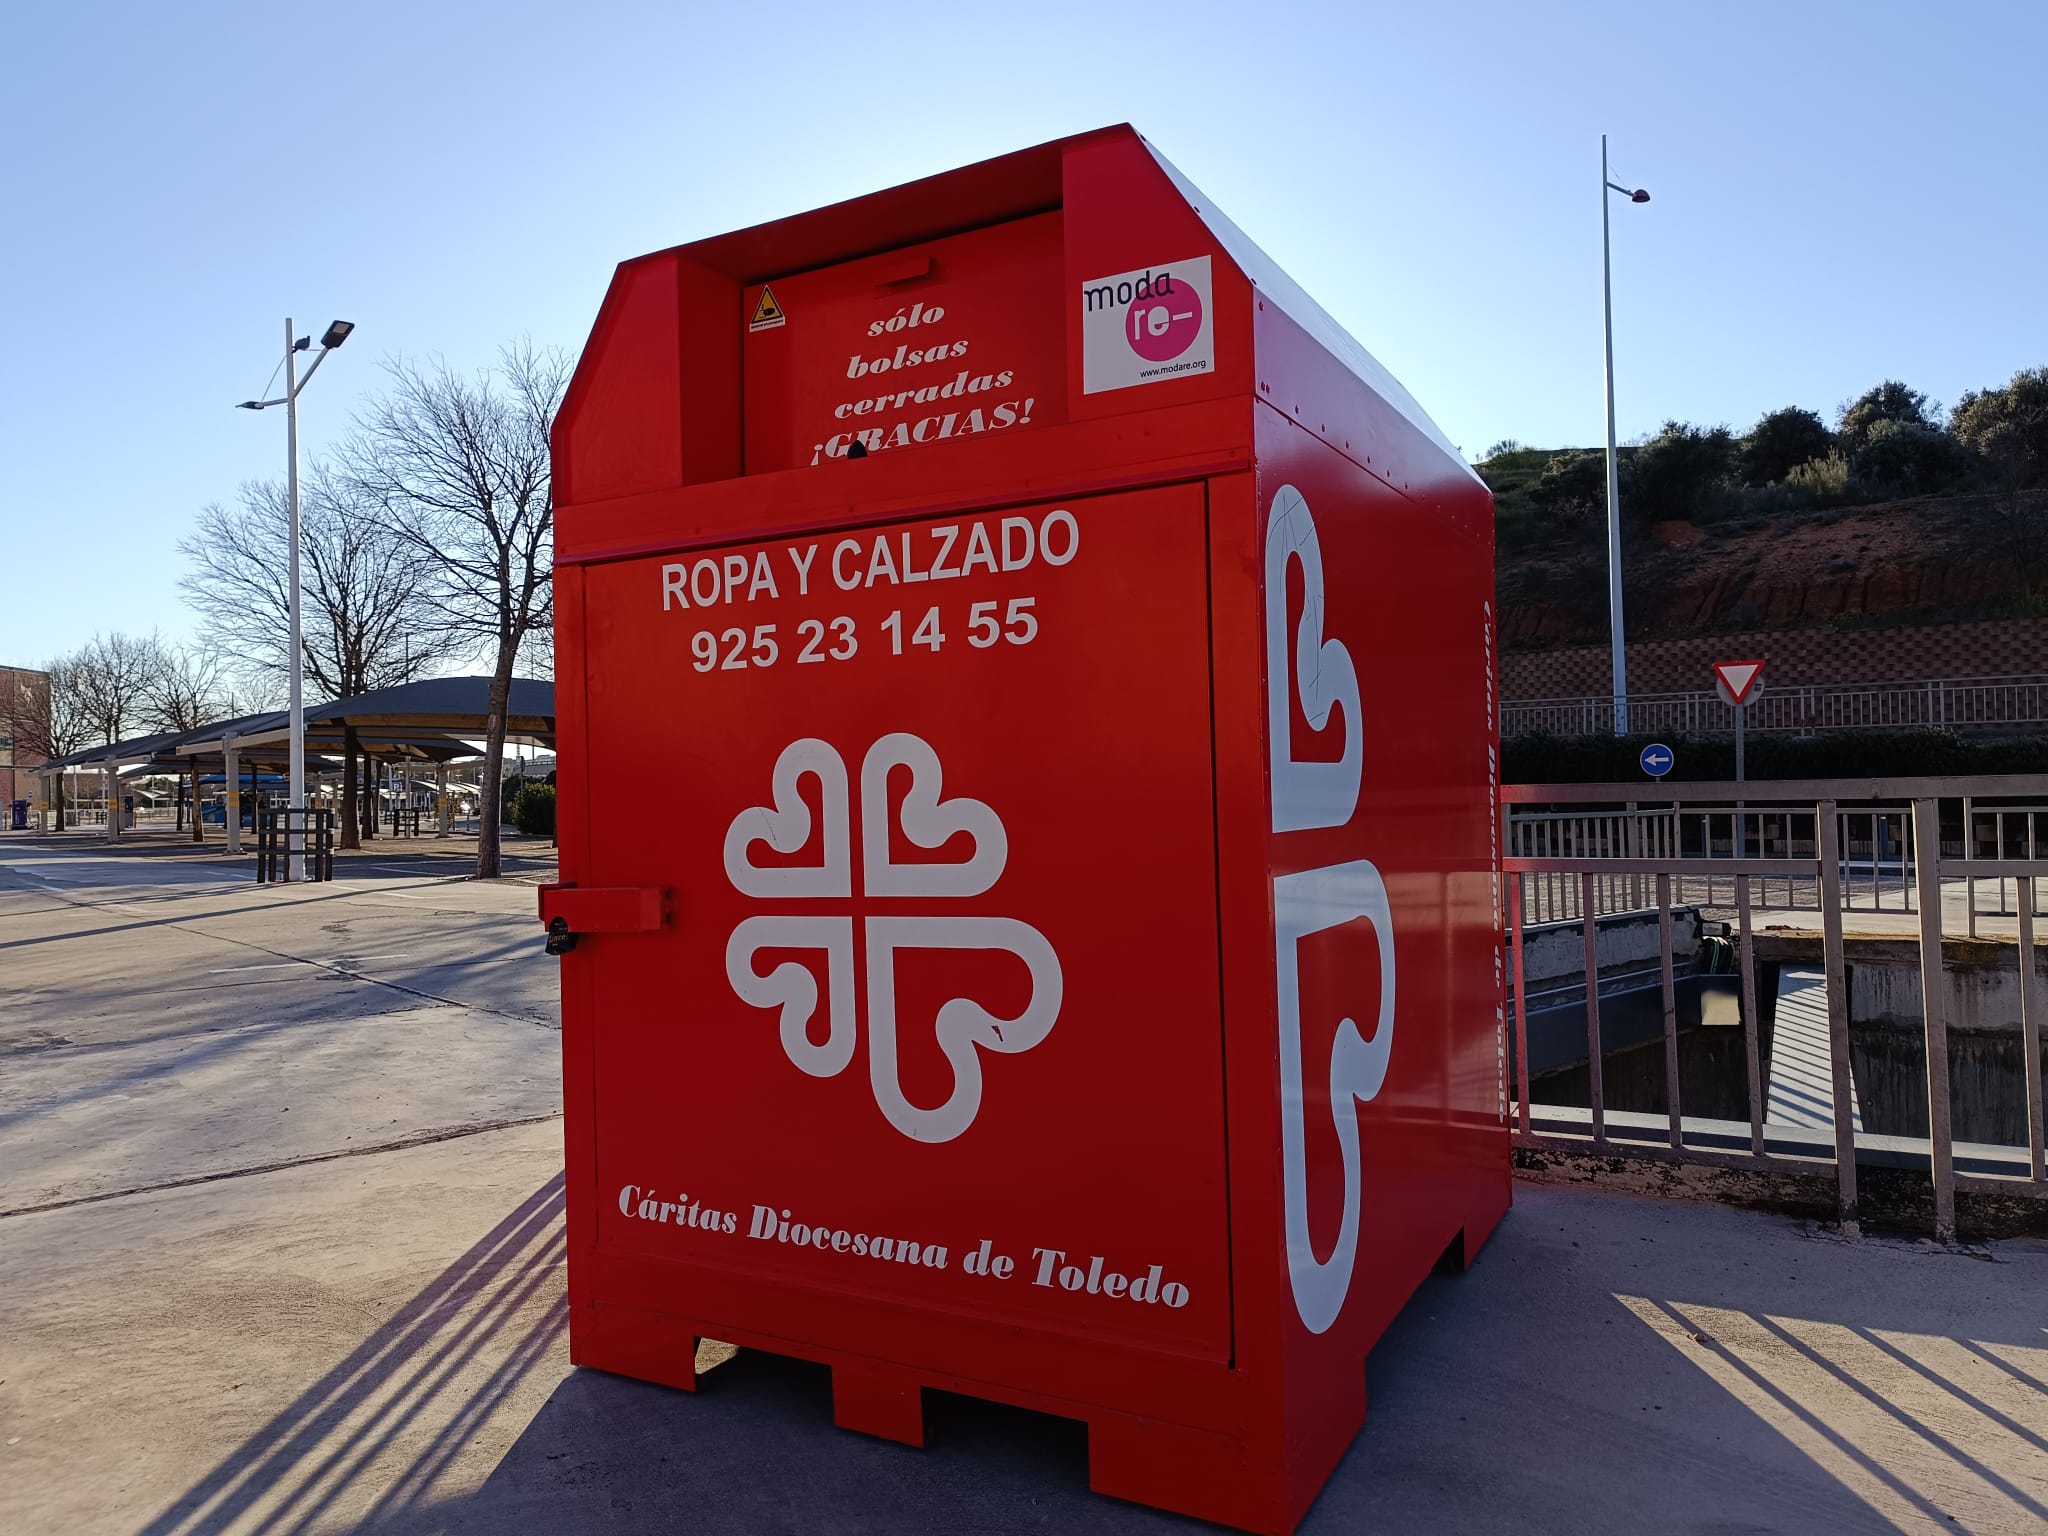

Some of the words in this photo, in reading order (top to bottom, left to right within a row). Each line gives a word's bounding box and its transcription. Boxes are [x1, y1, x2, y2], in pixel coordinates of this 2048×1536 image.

[1084, 270, 1175, 312] moda
[867, 302, 945, 337] sólo
[846, 340, 969, 379] bolsas
[1140, 360, 1206, 378] www.modare.org
[834, 370, 1014, 419] cerradas
[810, 398, 1035, 466] ¡GRACIAS!
[662, 551, 779, 611] ROPA
[788, 544, 818, 596] Y
[831, 509, 1080, 591] CALZADO
[691, 624, 779, 673] 925
[796, 616, 859, 664] 23
[880, 606, 946, 656] 14
[967, 596, 1039, 649] 55
[618, 1184, 737, 1234] Cáritas
[746, 1204, 948, 1269] Diocesana
[963, 1239, 1014, 1280] de
[1031, 1247, 1190, 1308] Toledo
